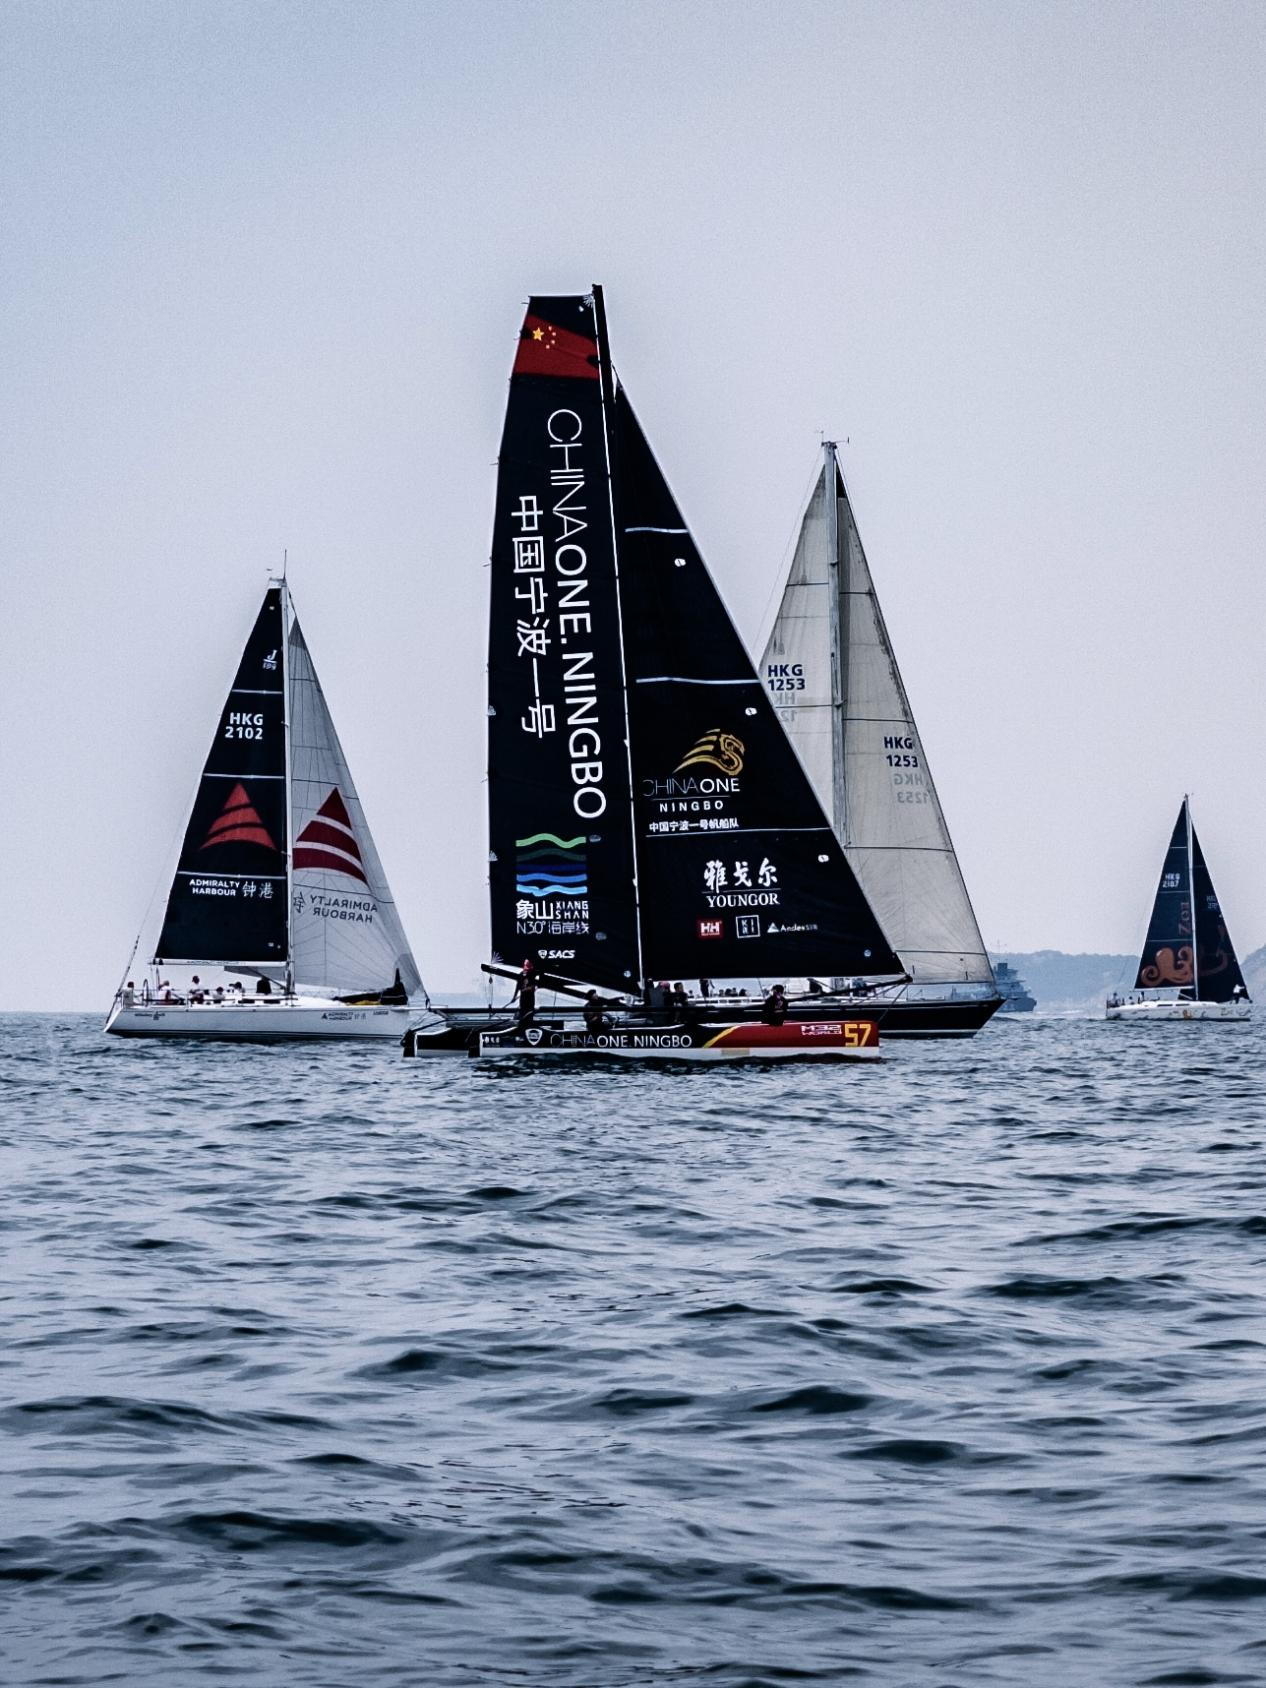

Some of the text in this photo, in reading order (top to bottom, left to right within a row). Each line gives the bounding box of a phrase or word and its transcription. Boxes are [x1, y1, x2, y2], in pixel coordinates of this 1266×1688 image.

[511, 495, 556, 738] 中国宁波一号
[767, 664, 803, 677] HKG
[767, 679, 806, 691] 1253
[229, 712, 264, 726] HKG
[224, 726, 264, 740] 2102
[561, 652, 607, 819] NINGBO
[884, 736, 913, 749] HKG
[886, 754, 918, 767] 1253
[659, 800, 724, 813] NINGBO
[703, 857, 778, 894] 雅戈尔
[189, 879, 240, 889] ADMIRALTY
[192, 887, 236, 897] HARBOUR
[556, 900, 589, 910] XIANG
[706, 893, 781, 908] YOUNGOR
[516, 899, 555, 920] 象山
[556, 910, 589, 919] SHAN
[548, 950, 576, 959] SACS
[633, 1034, 692, 1048] NINGBO
[844, 1023, 871, 1047] 57
